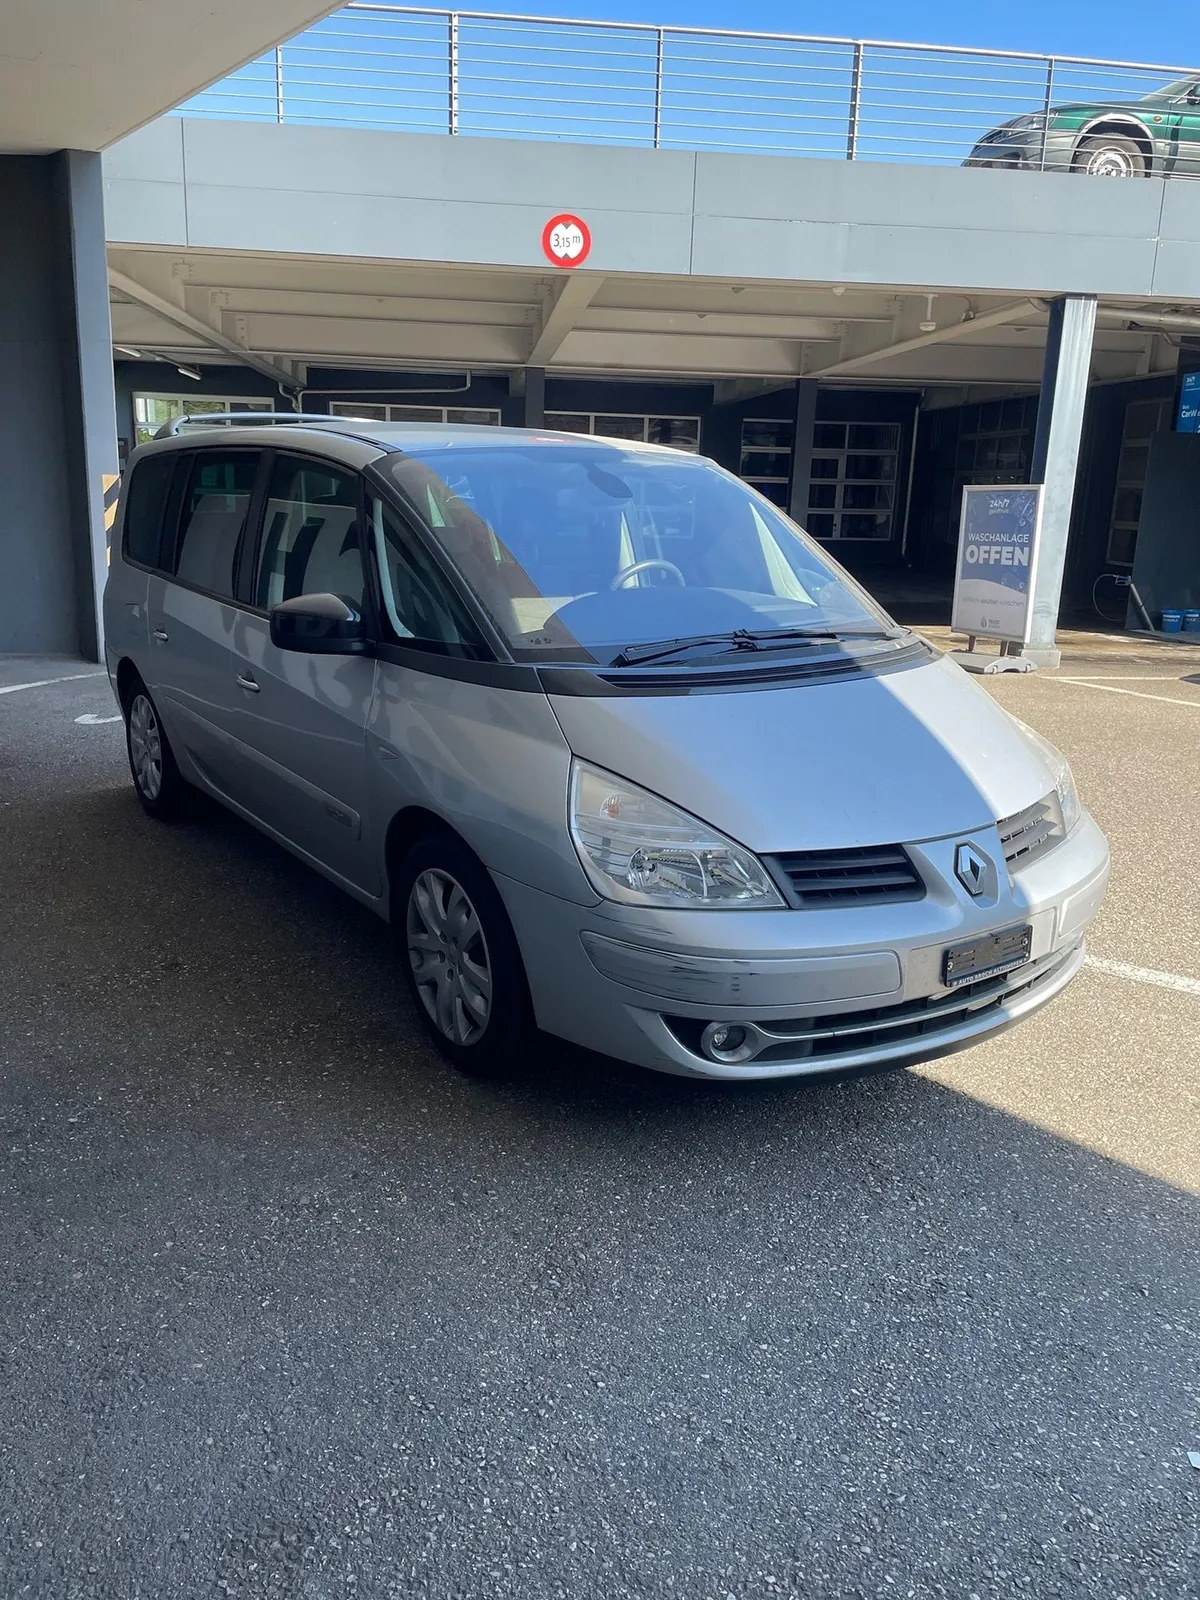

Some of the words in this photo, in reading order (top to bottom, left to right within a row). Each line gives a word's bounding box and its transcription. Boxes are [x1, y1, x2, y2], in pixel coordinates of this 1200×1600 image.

[553, 233, 571, 249] 3,15
[572, 235, 581, 244] m
[989, 498, 1010, 508] 24h/7
[968, 533, 1030, 543] WASCHANLAGE
[965, 544, 1030, 567] OFFEN
[959, 976, 974, 985] AUTO
